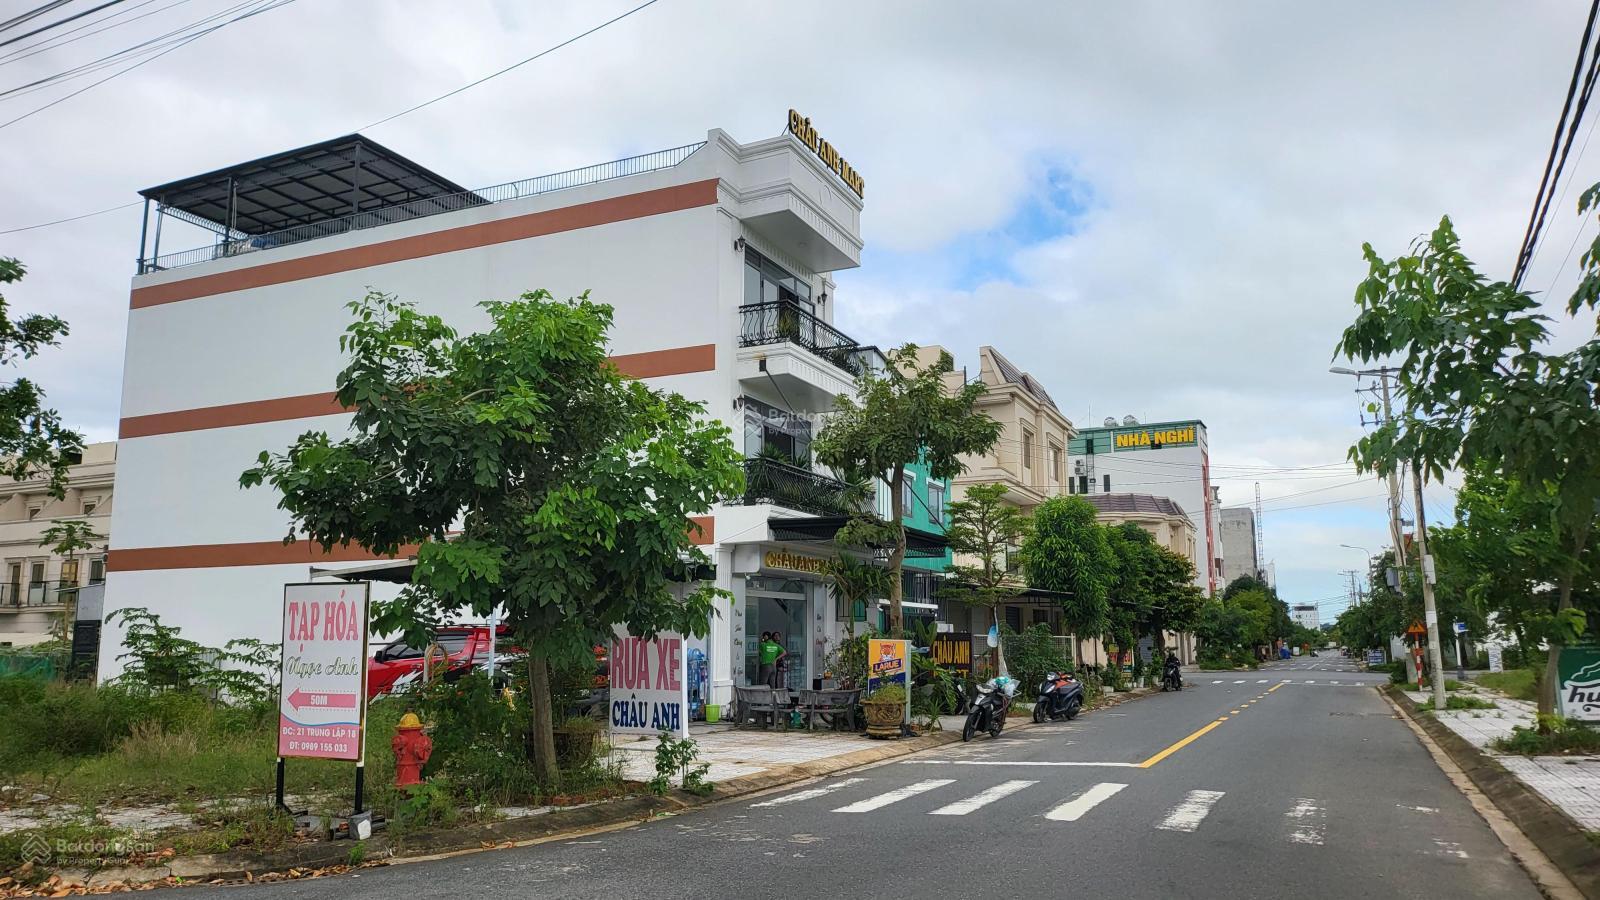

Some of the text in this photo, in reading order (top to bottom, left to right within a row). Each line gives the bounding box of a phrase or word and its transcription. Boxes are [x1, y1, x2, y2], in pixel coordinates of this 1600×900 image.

[789, 108, 819, 154] CHÂU
[818, 138, 840, 175] ANH
[1116, 426, 1194, 447] NHÀ NGHỈ
[288, 589, 359, 653] TẠP HÓA
[954, 640, 970, 664] ANH
[286, 656, 359, 678] Ngọc Anh
[656, 638, 681, 691] XE
[874, 660, 900, 672] LARUE
[310, 695, 328, 706] 50M
[612, 692, 680, 731] CHÂU ANH
[282, 726, 296, 736] ĐC:
[296, 727, 305, 736] 21
[306, 727, 331, 738] TRUNG
[332, 727, 347, 741] LẬP
[289, 741, 348, 752] ĐT: 0989 155 033
